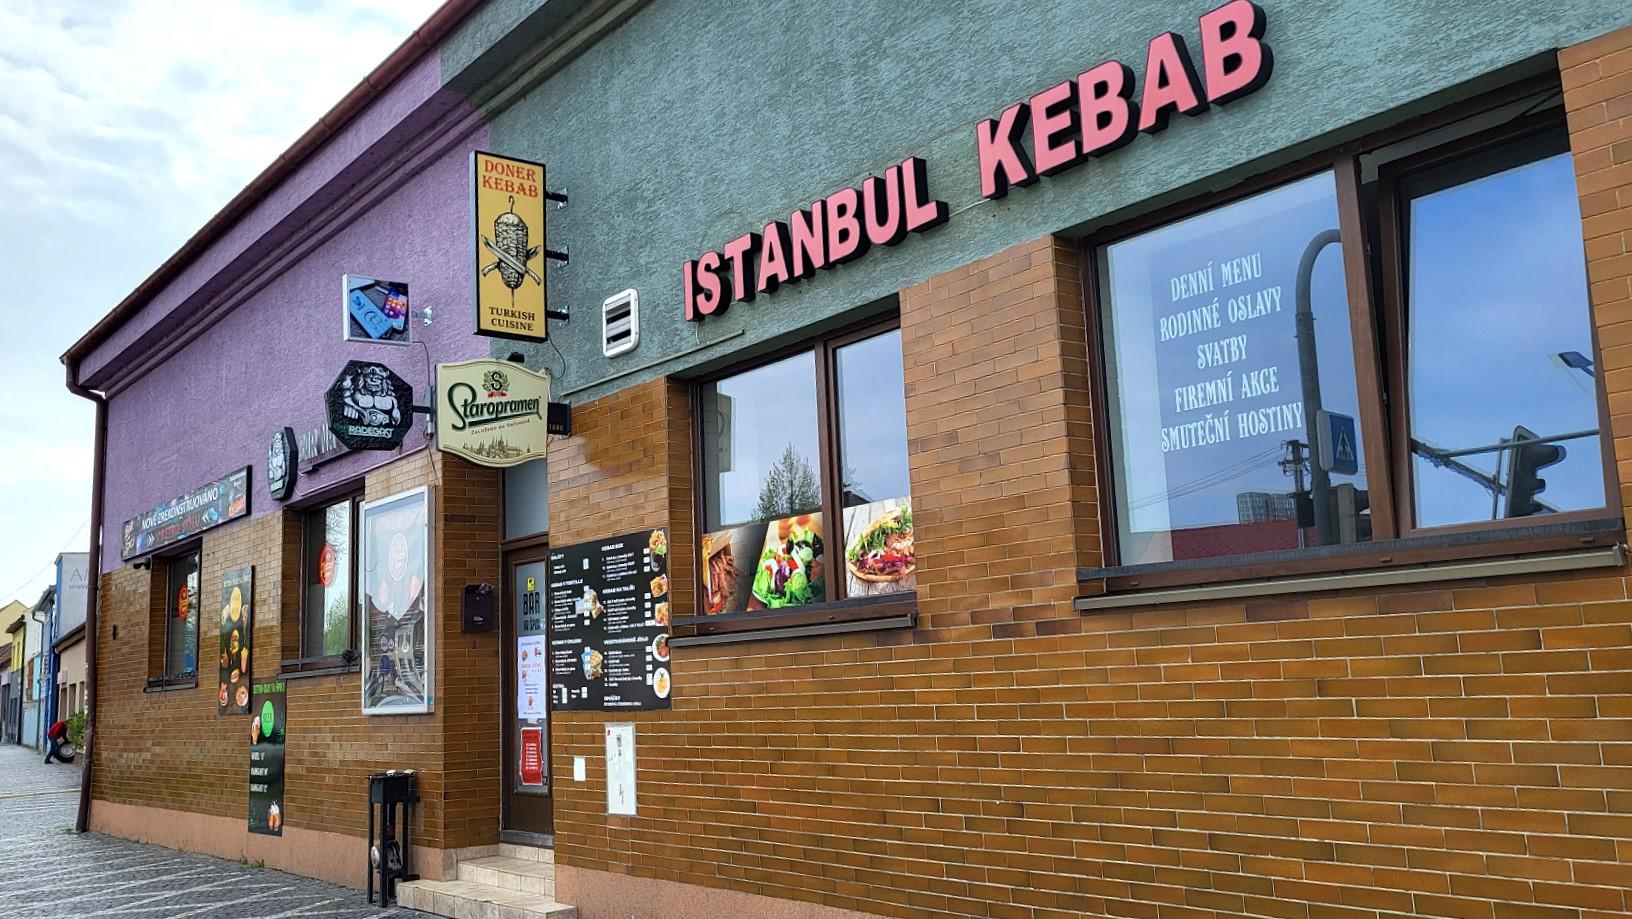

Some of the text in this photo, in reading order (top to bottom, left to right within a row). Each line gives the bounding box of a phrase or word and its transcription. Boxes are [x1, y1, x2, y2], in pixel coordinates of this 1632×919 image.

[484, 160, 537, 182] DONER
[683, 0, 1269, 322] ISTANBUL KEBAB
[482, 175, 538, 198] KEBAB
[1170, 252, 1263, 302] DENNÍ MENU
[489, 306, 536, 321] TURKISH
[491, 318, 534, 331] CUISINE
[1159, 286, 1282, 341] RODINNÉ OSLAVY
[1197, 334, 1248, 369] SVATBY
[447, 382, 543, 431] Staropramen
[1174, 366, 1279, 412] FIREMNÍ AKCE
[349, 425, 394, 438] RADEGAST
[1161, 402, 1303, 452] SMUTEČNÍ HOSTINY
[523, 592, 540, 615] BAR
